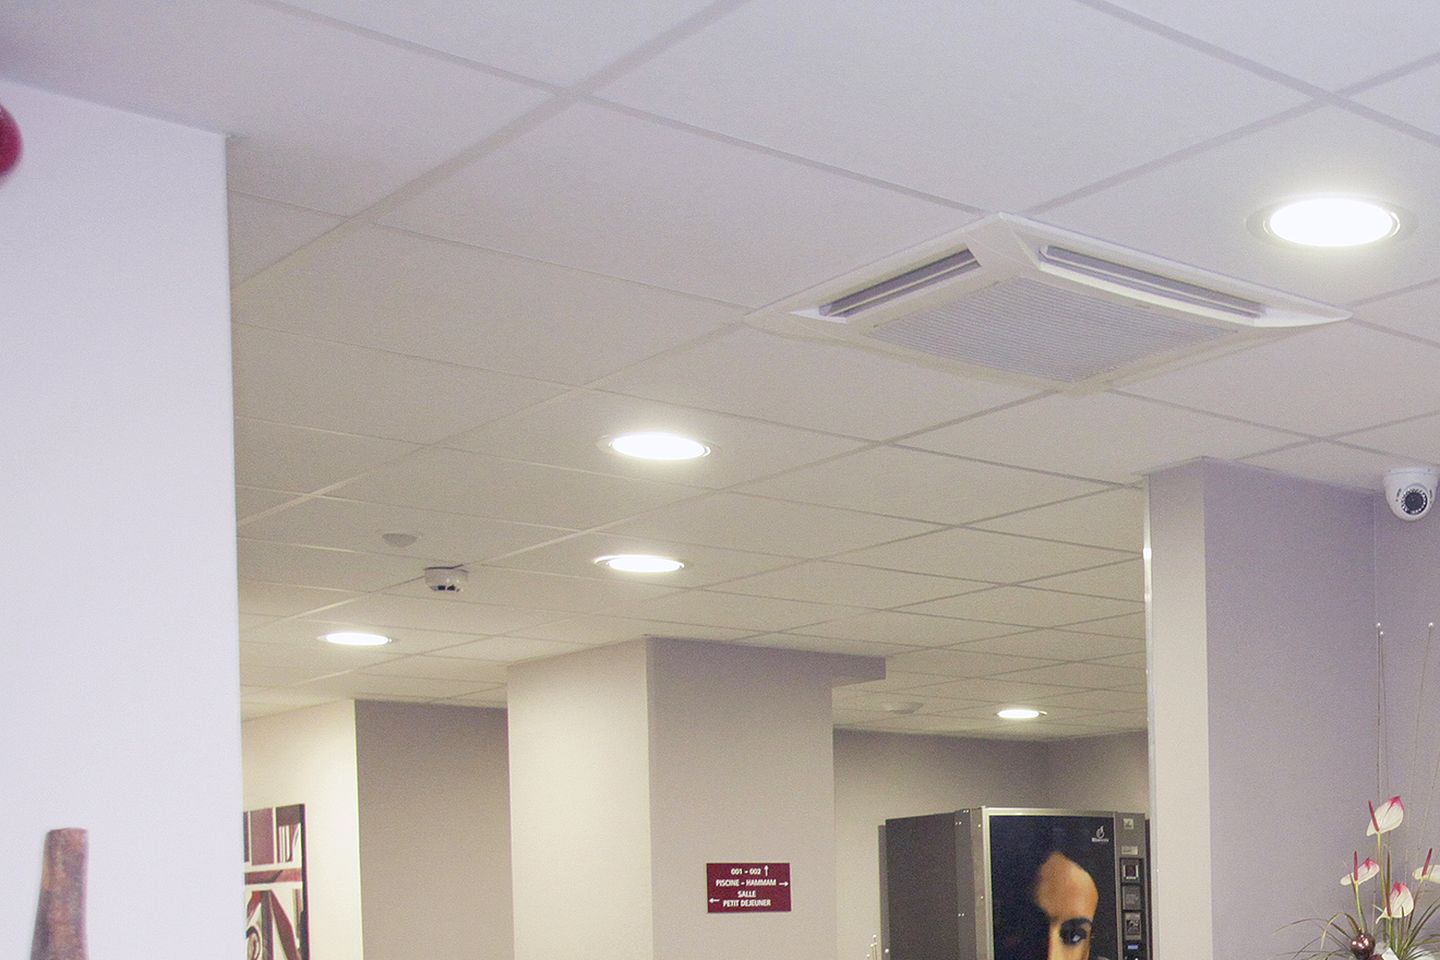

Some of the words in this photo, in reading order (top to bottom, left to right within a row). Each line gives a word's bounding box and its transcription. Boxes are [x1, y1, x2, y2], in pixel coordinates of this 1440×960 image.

[715, 879, 740, 887] PISCINE
[745, 879, 777, 887] HAMMAM
[737, 890, 757, 898] SALLE
